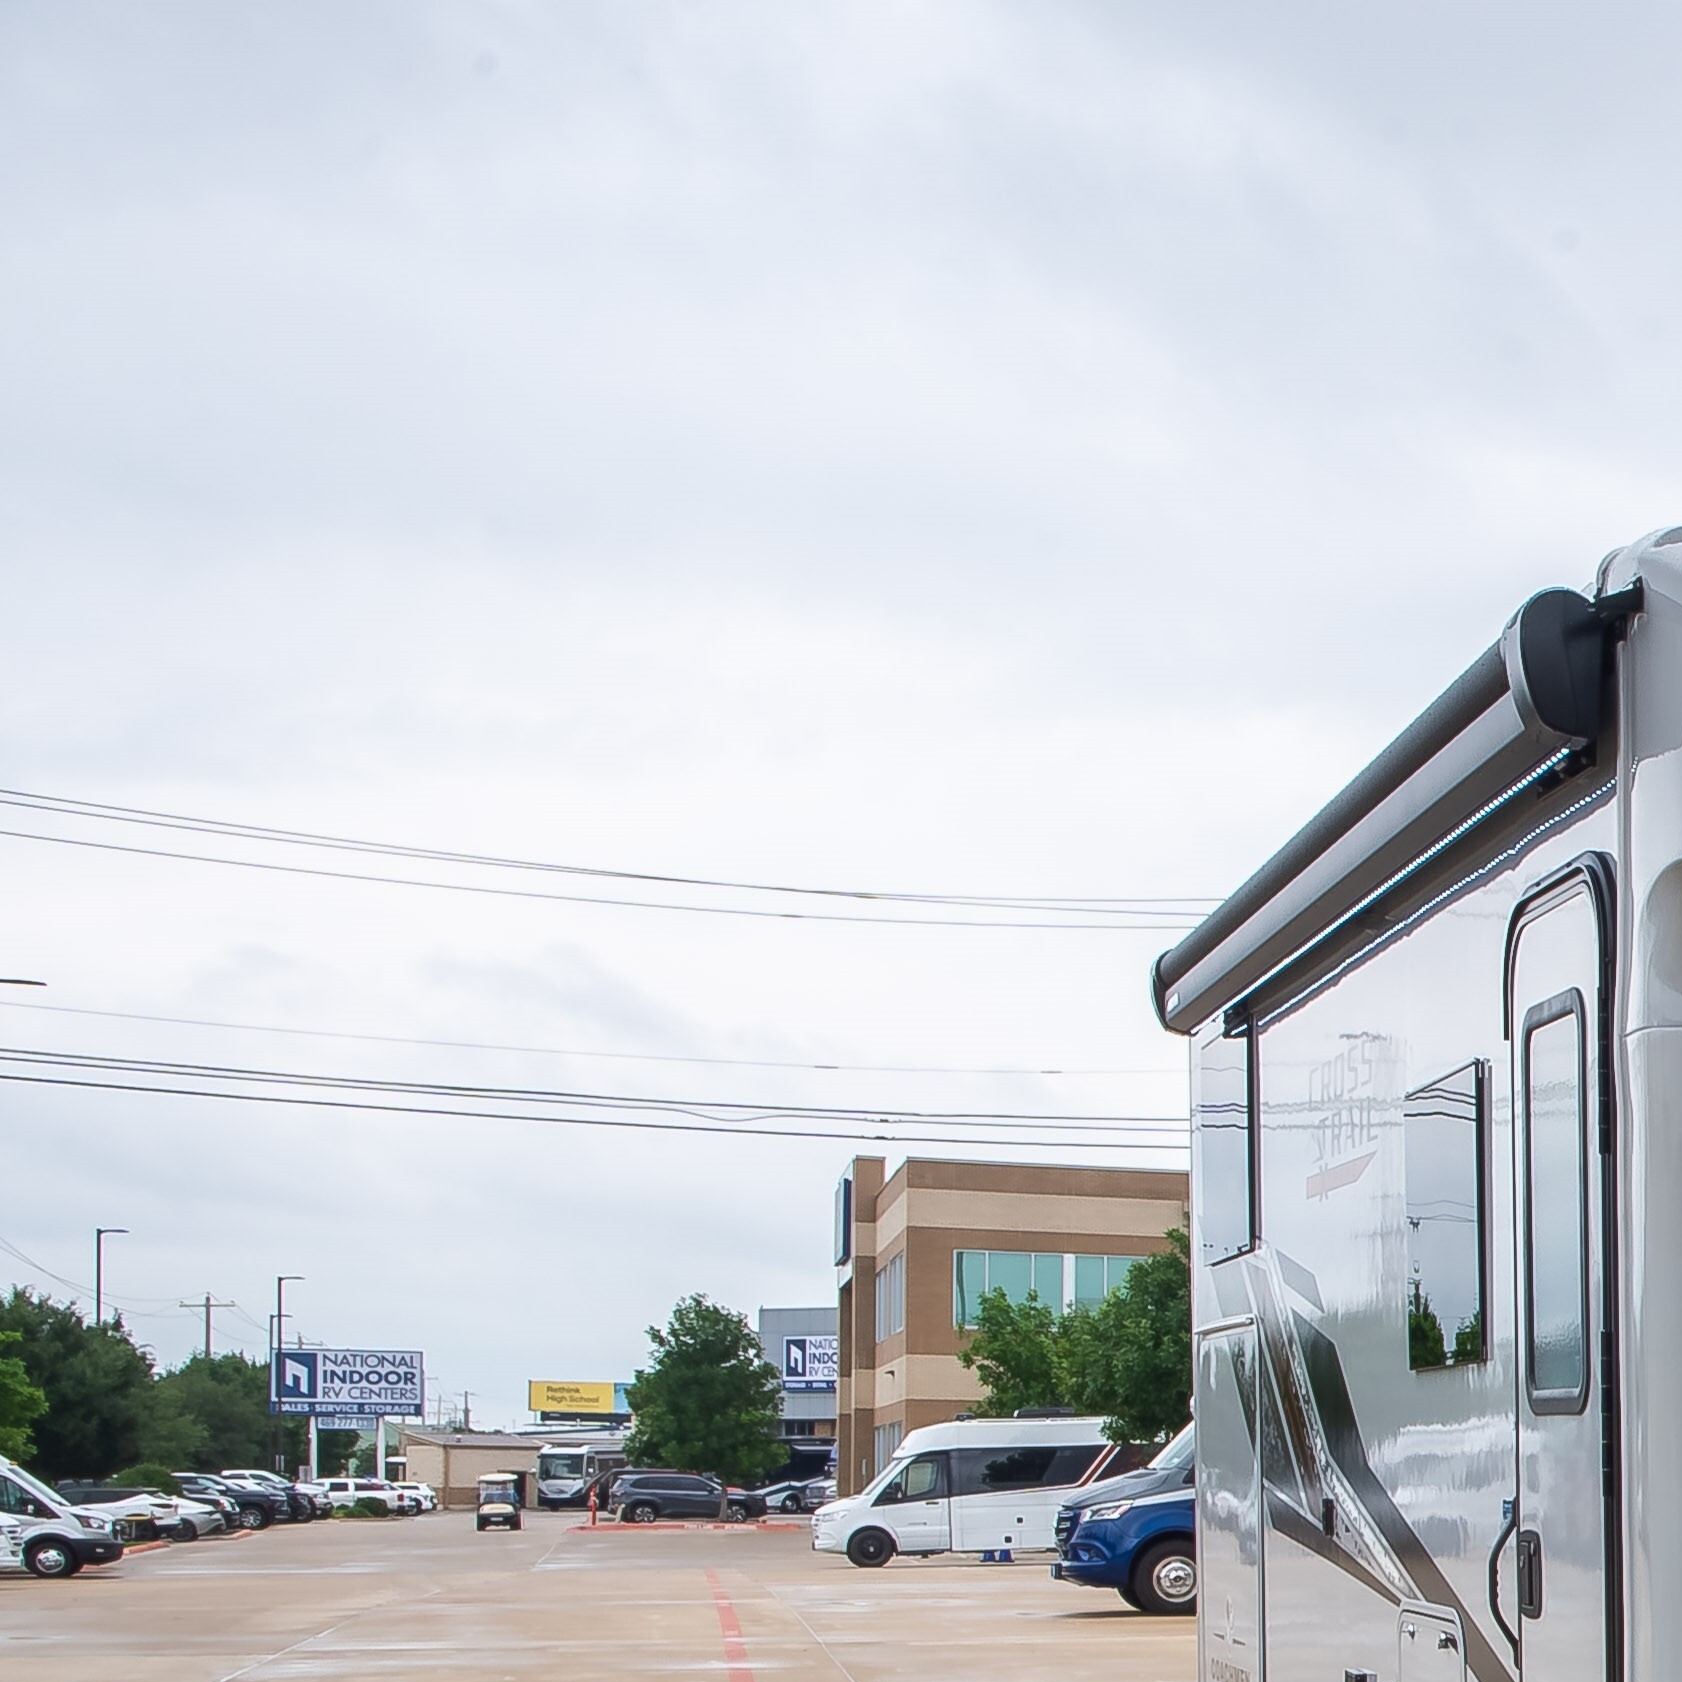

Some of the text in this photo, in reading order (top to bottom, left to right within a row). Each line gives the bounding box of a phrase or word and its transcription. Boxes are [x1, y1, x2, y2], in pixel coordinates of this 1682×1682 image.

[1308, 1040, 1373, 1110] CROSS
[1318, 1099, 1378, 1158] TRAIL
[322, 1353, 417, 1369] NATIONAL
[322, 1370, 417, 1386] INDOOR
[322, 1386, 418, 1400] RV CENTERS
[546, 1386, 581, 1394] Rethink
[546, 1394, 600, 1404] High School
[314, 1404, 359, 1413] SERVICE
[363, 1405, 416, 1414] STORAGE
